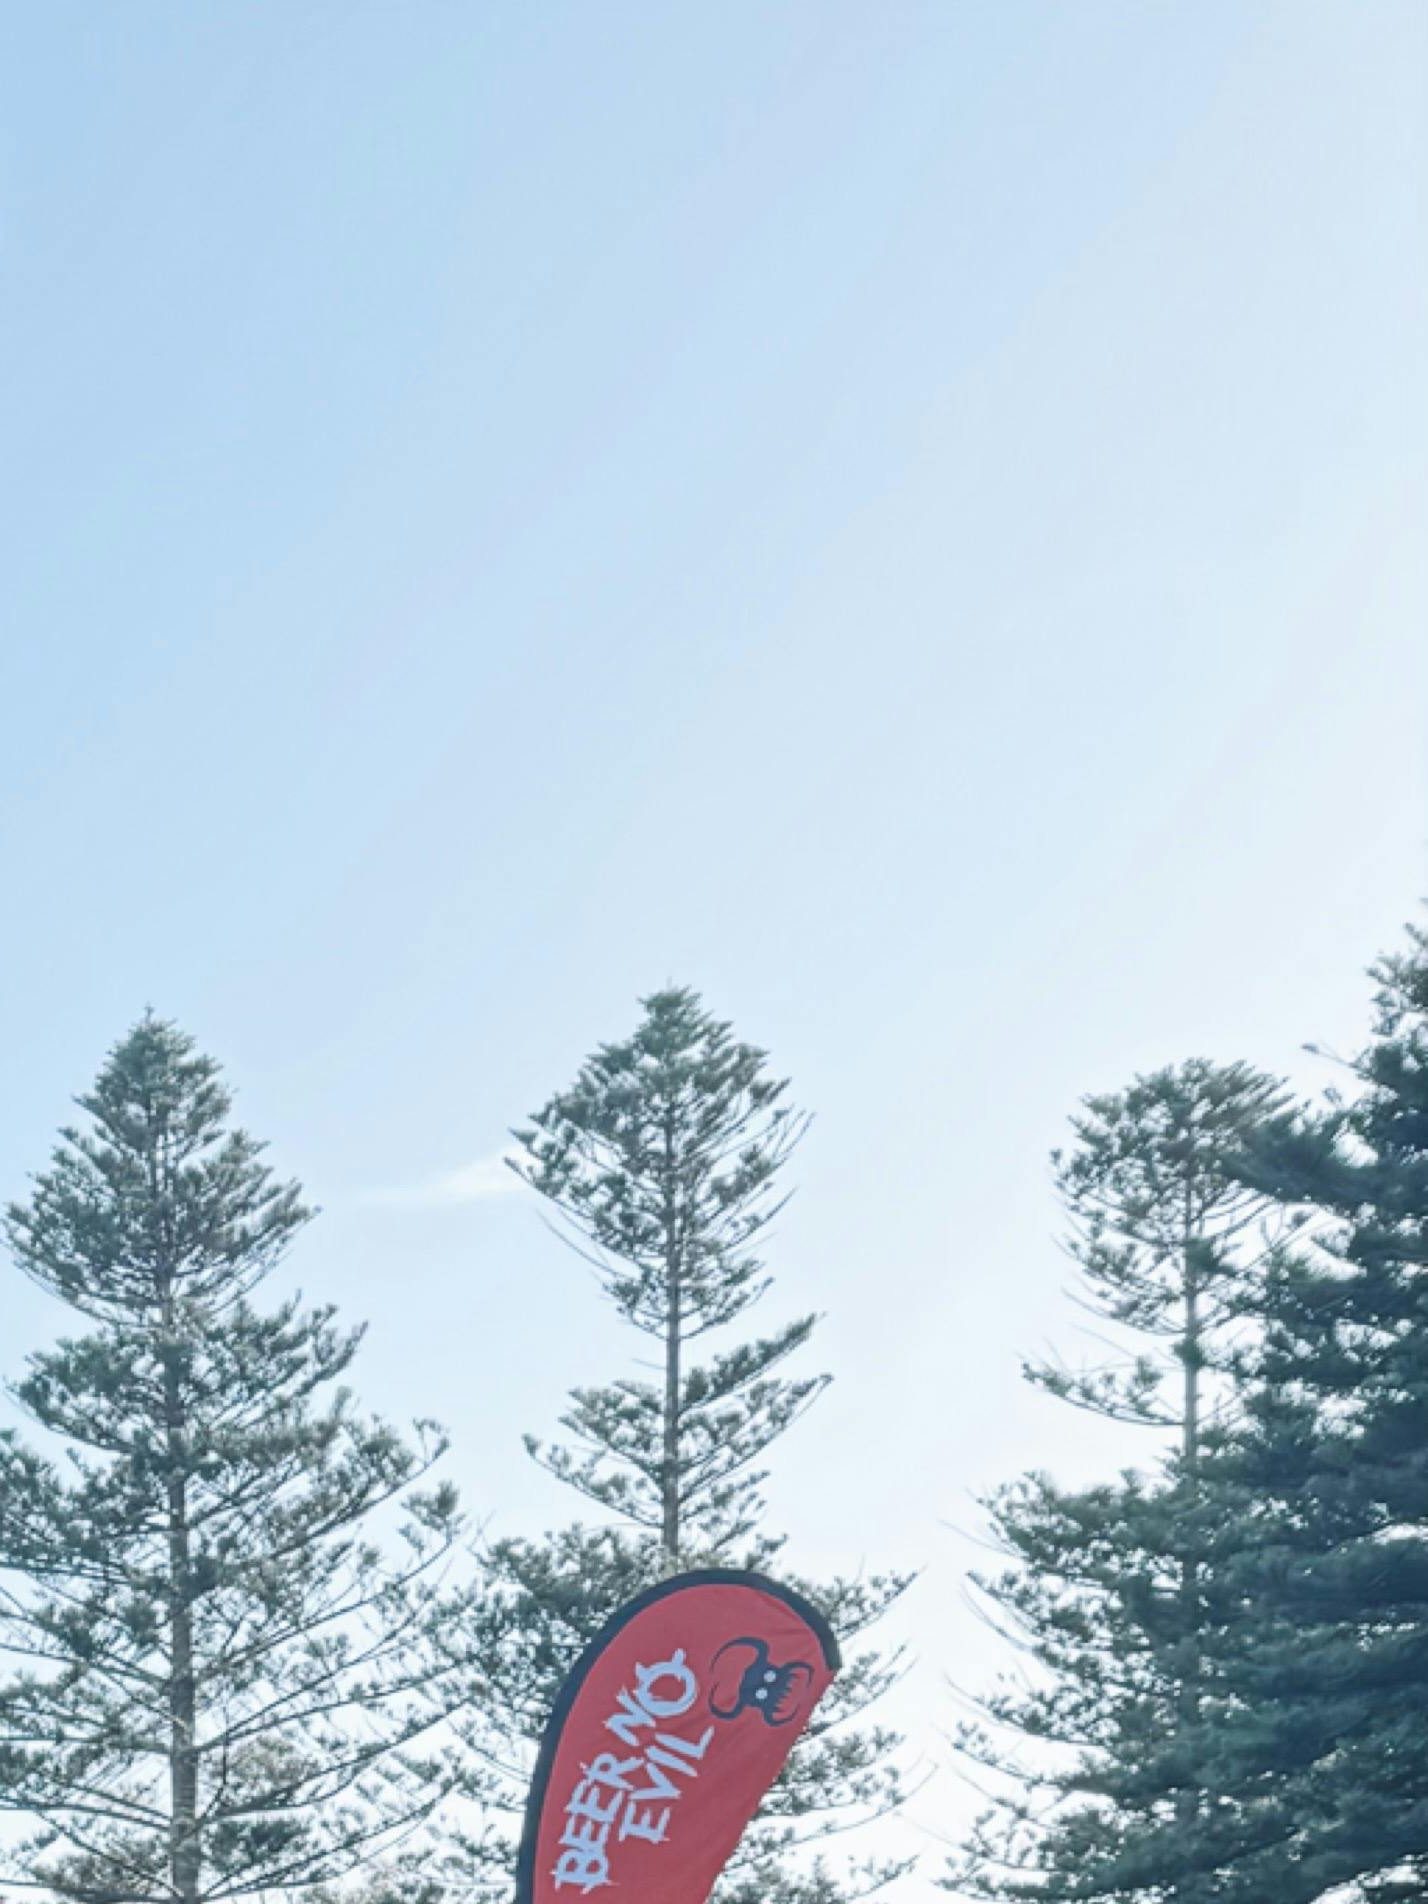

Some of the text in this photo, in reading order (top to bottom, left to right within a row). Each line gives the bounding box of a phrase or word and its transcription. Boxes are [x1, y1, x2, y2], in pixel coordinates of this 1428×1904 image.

[550, 1648, 697, 1894] BEER NO
[619, 1726, 715, 1843] EVIL
